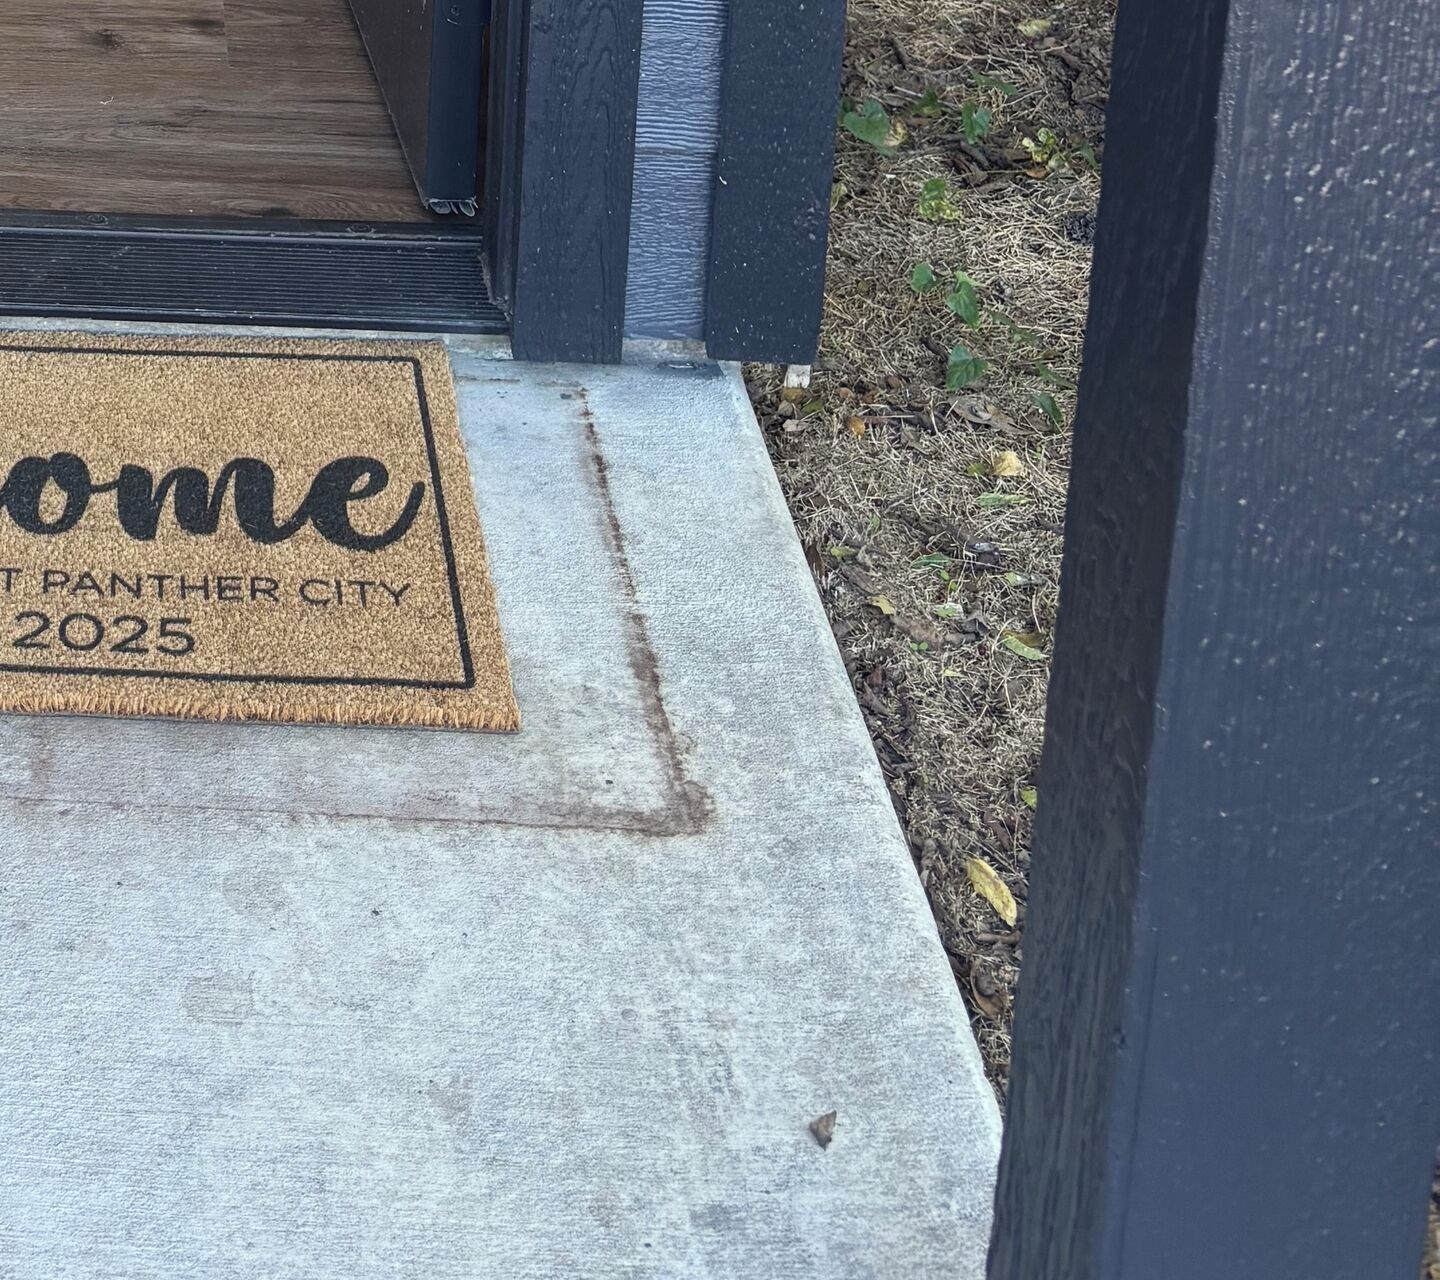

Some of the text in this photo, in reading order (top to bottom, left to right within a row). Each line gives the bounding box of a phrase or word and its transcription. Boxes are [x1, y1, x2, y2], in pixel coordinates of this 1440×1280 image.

[42, 569, 280, 603] PANTHER
[298, 578, 411, 608] CITY
[12, 611, 196, 657] 2025
